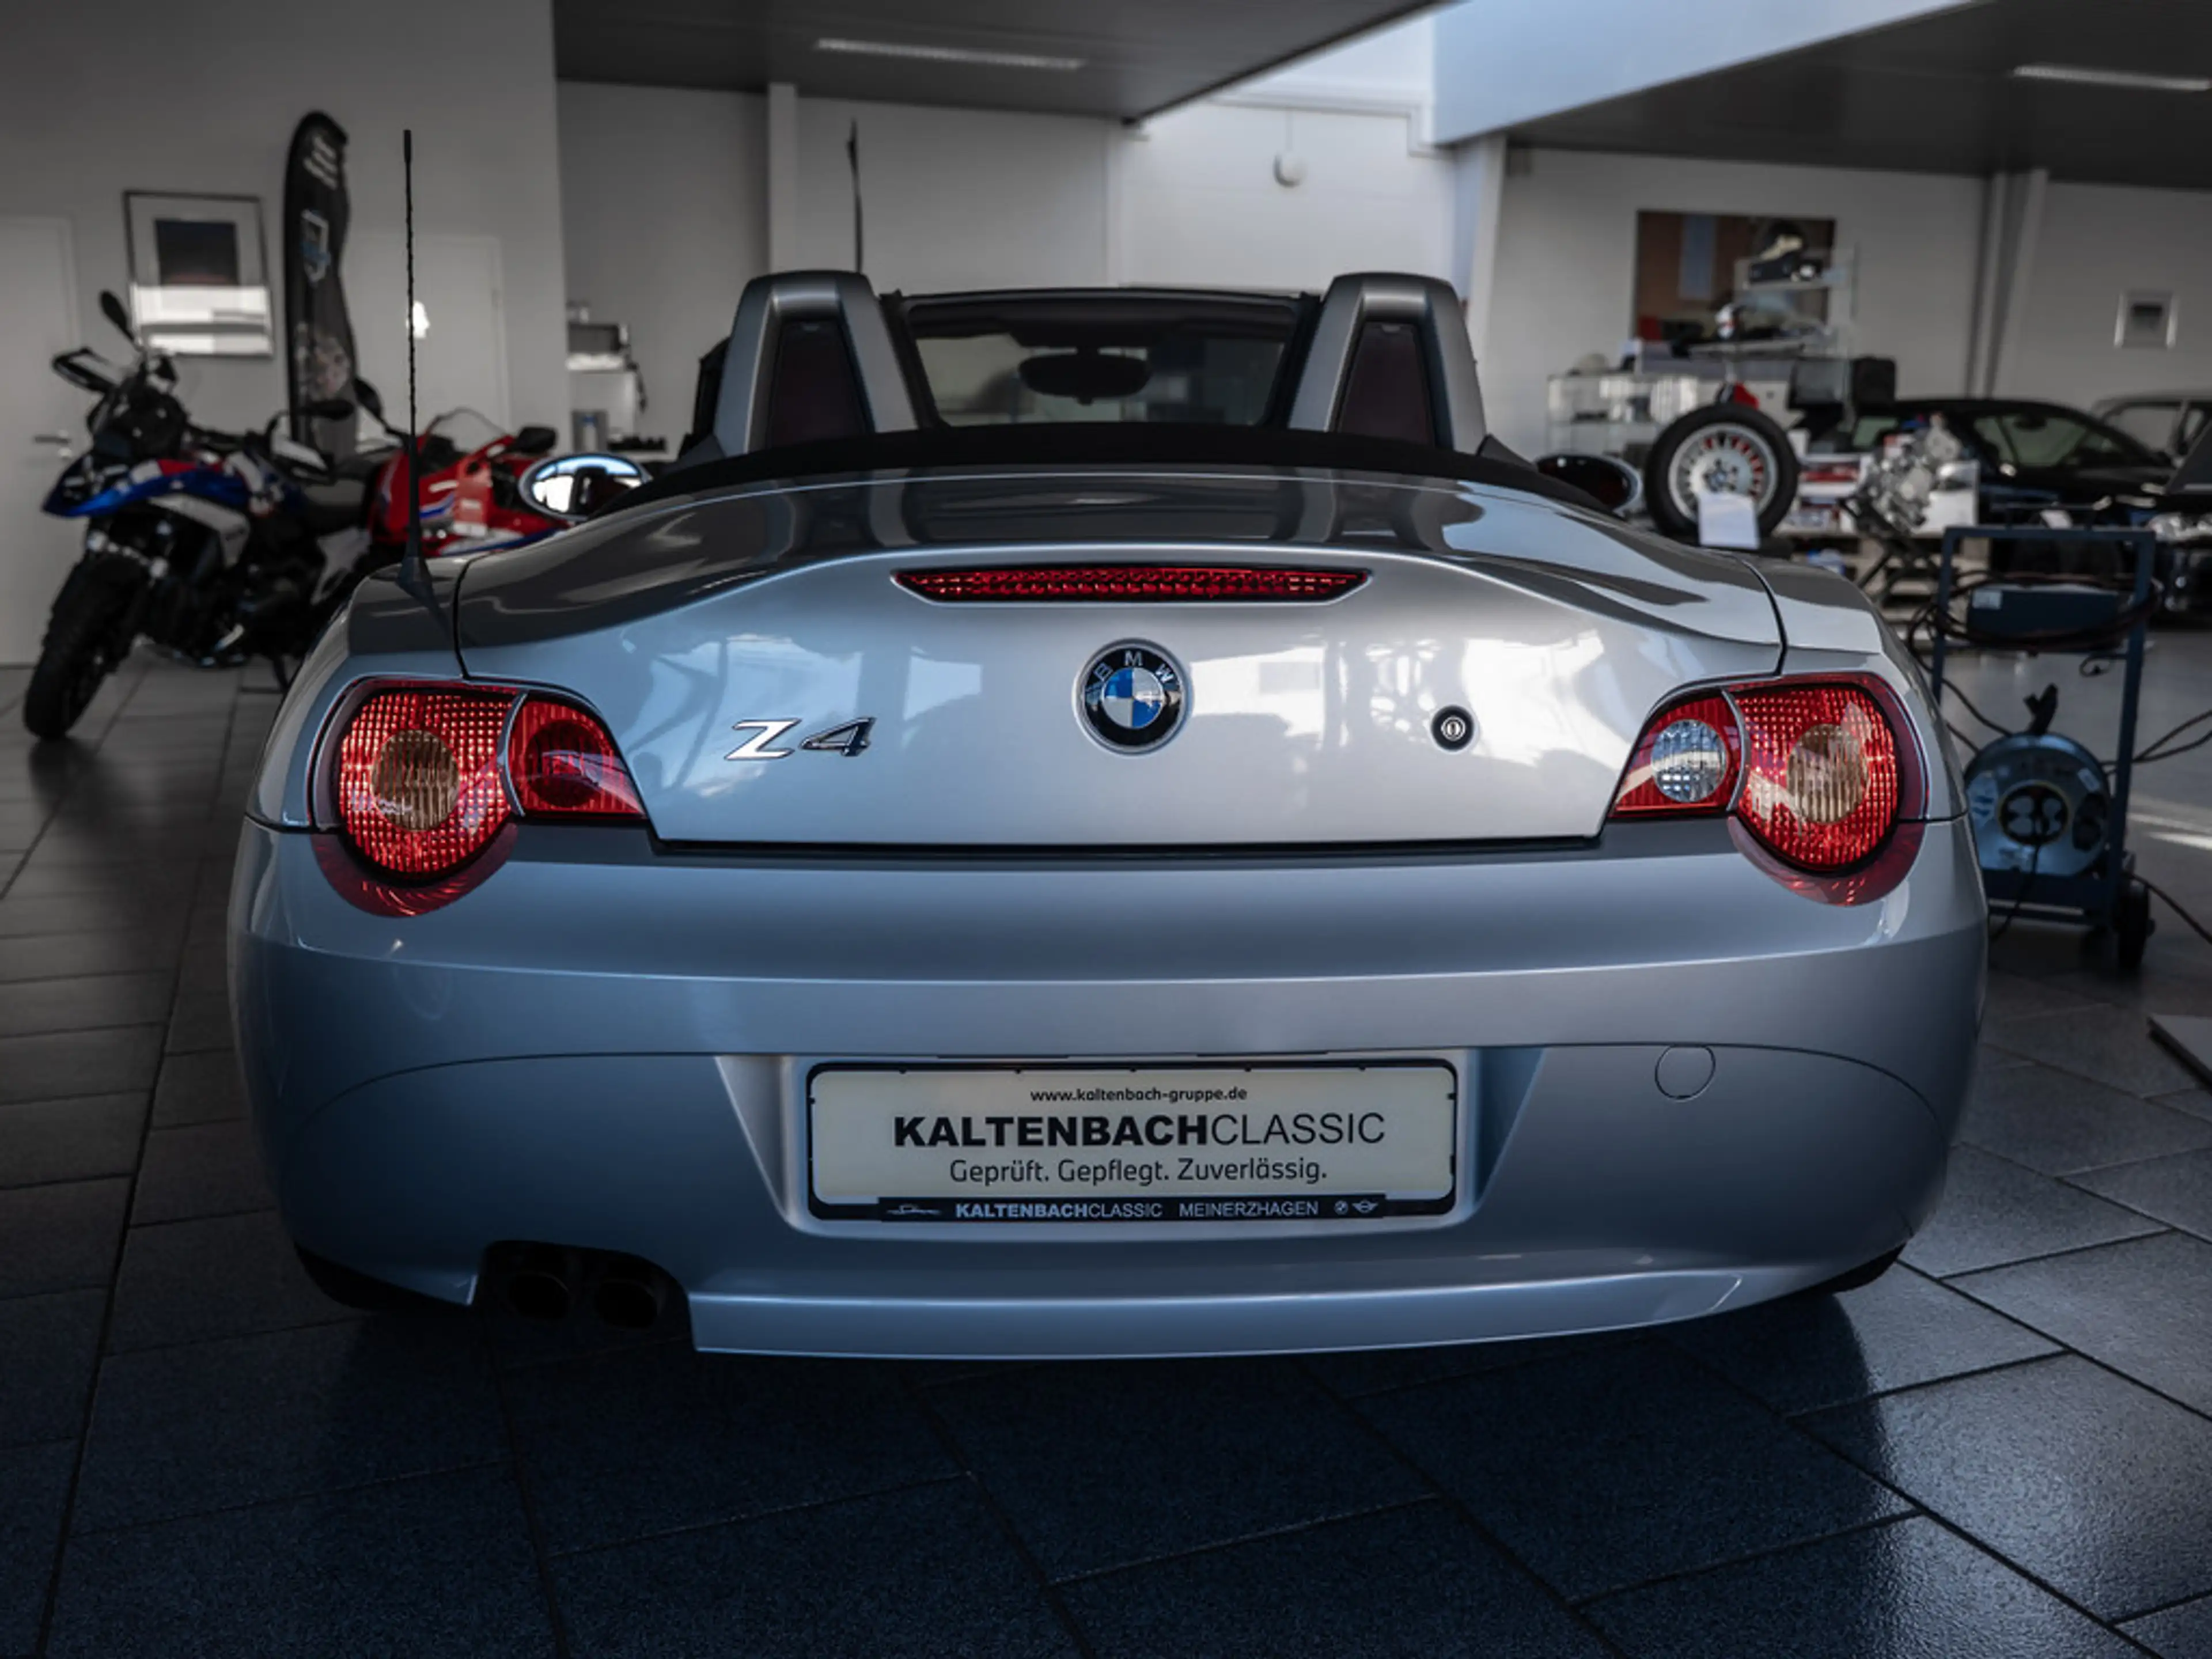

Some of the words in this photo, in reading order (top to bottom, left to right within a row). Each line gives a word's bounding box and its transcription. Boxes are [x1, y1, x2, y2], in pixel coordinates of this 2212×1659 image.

[1093, 650, 1174, 682] BMW
[724, 717, 877, 761] Z4
[1029, 1086, 1248, 1104] www.kaltenbach-gruppe.de
[894, 1112, 1385, 1147] KALTENBACHCLASSIC
[950, 1159, 1050, 1187] Geprüft.
[1058, 1158, 1169, 1187] Gepflegt.
[1177, 1157, 1328, 1185] Zuverlässig.
[955, 1203, 1163, 1218] KALTENBACHCLASSIC
[1179, 1200, 1319, 1218] MEINERZHAGEN
